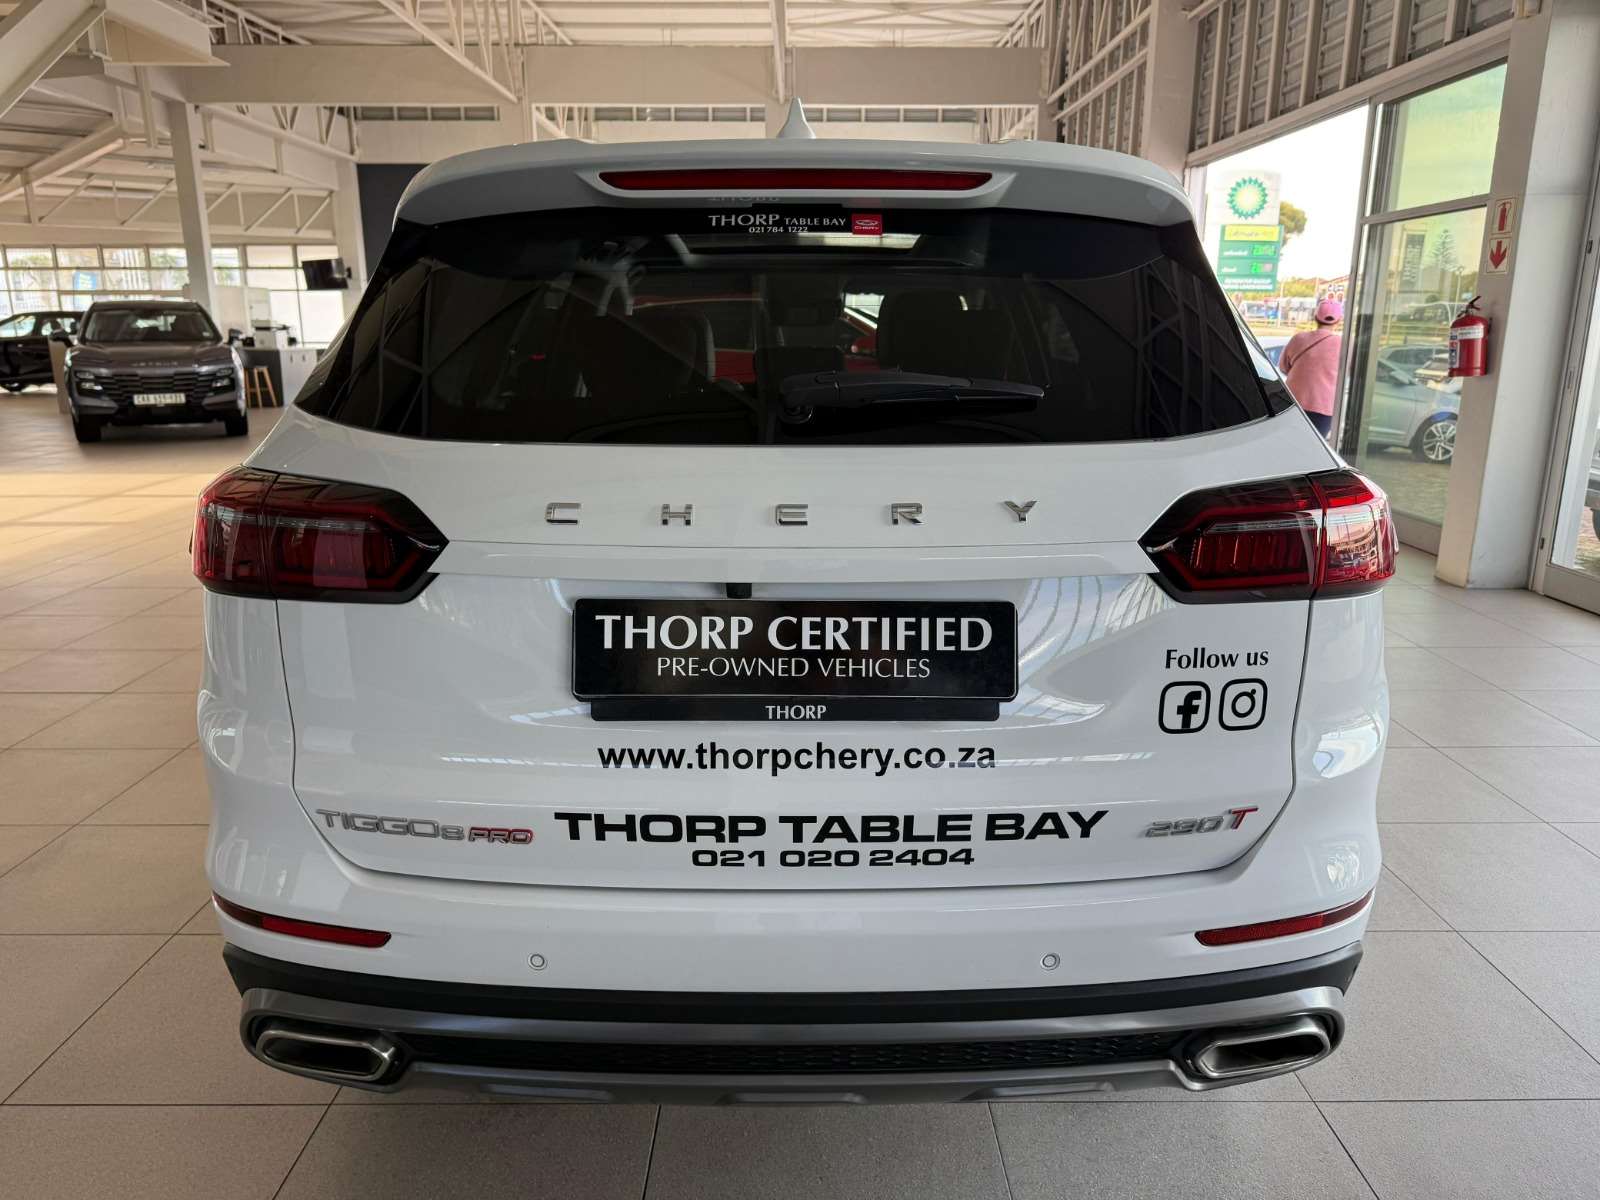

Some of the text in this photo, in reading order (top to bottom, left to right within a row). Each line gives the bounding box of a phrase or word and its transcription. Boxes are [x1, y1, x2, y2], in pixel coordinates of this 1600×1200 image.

[708, 214, 846, 227] THORP TABLE BAY
[546, 501, 1037, 526] CHERY
[595, 615, 993, 651] THORP CERTIFIED
[657, 657, 931, 679] PRE-OWNED VEHICLES
[1165, 648, 1269, 669] Follow us
[764, 704, 827, 719] THORP
[598, 741, 995, 777] www.thorpchery.co.za
[468, 826, 535, 844] PRO
[554, 811, 1109, 844] THORP TABLE BAY
[691, 848, 975, 867] 021 020 2404
